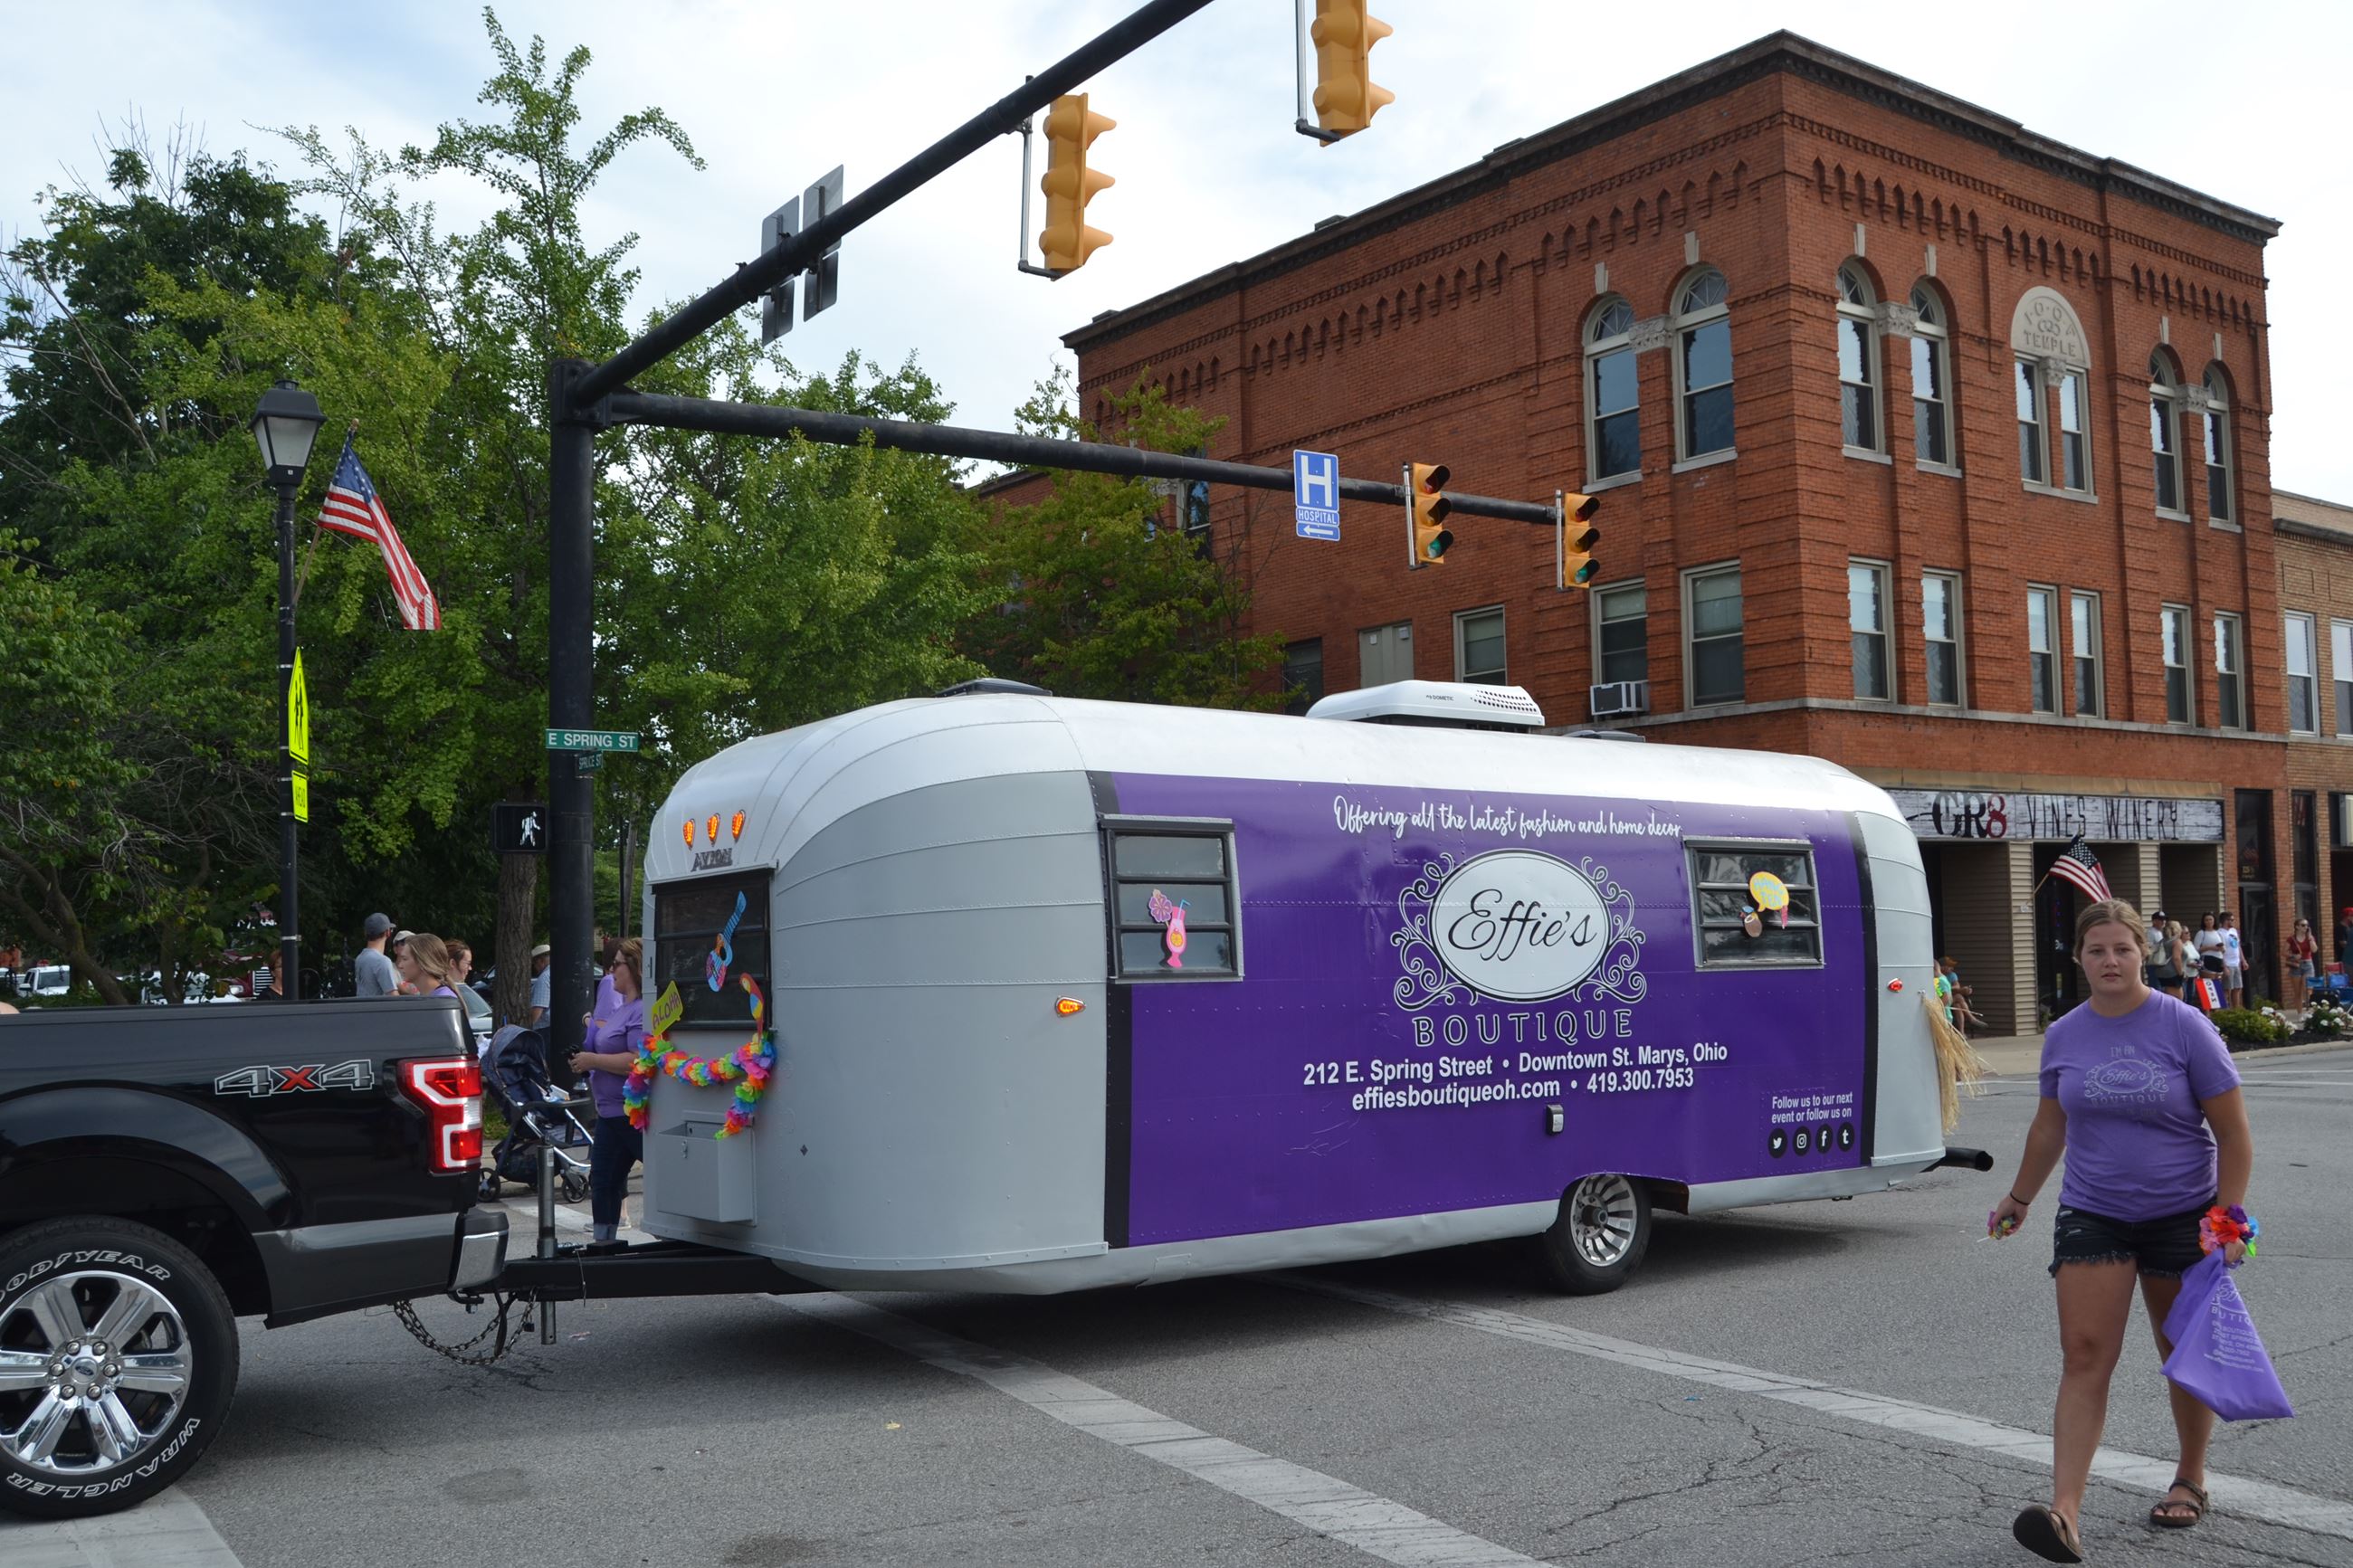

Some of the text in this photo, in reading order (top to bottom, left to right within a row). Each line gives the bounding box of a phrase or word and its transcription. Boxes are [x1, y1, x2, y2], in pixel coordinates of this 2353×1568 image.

[2024, 329, 2076, 356] TEMPLE
[1300, 455, 1332, 508] H
[1298, 509, 1337, 524] HOSPITAL
[548, 732, 635, 748] E SPRING ST
[1334, 795, 1681, 840] Offering all the latest fashion and home decor
[2026, 795, 2086, 839] VINES
[2104, 798, 2178, 841] WINERY
[1448, 889, 1598, 962] Effie's
[652, 992, 682, 1030] ALOHA
[1412, 1009, 1633, 1047] BOUTIQUE
[1303, 1041, 1728, 1085] 212 E. Spring Street Downtown St. Marys, Ohio
[2100, 1069, 2149, 1086] Effie's
[1352, 1068, 1694, 1111] effiesboutiqueoh.com 419.300.7953
[1772, 1091, 1853, 1109] Follow us to our next
[2091, 1093, 2167, 1106] BOUTIQUE
[1771, 1107, 1853, 1124] event or follow us on
[6, 1417, 201, 1499] WRANGLER
